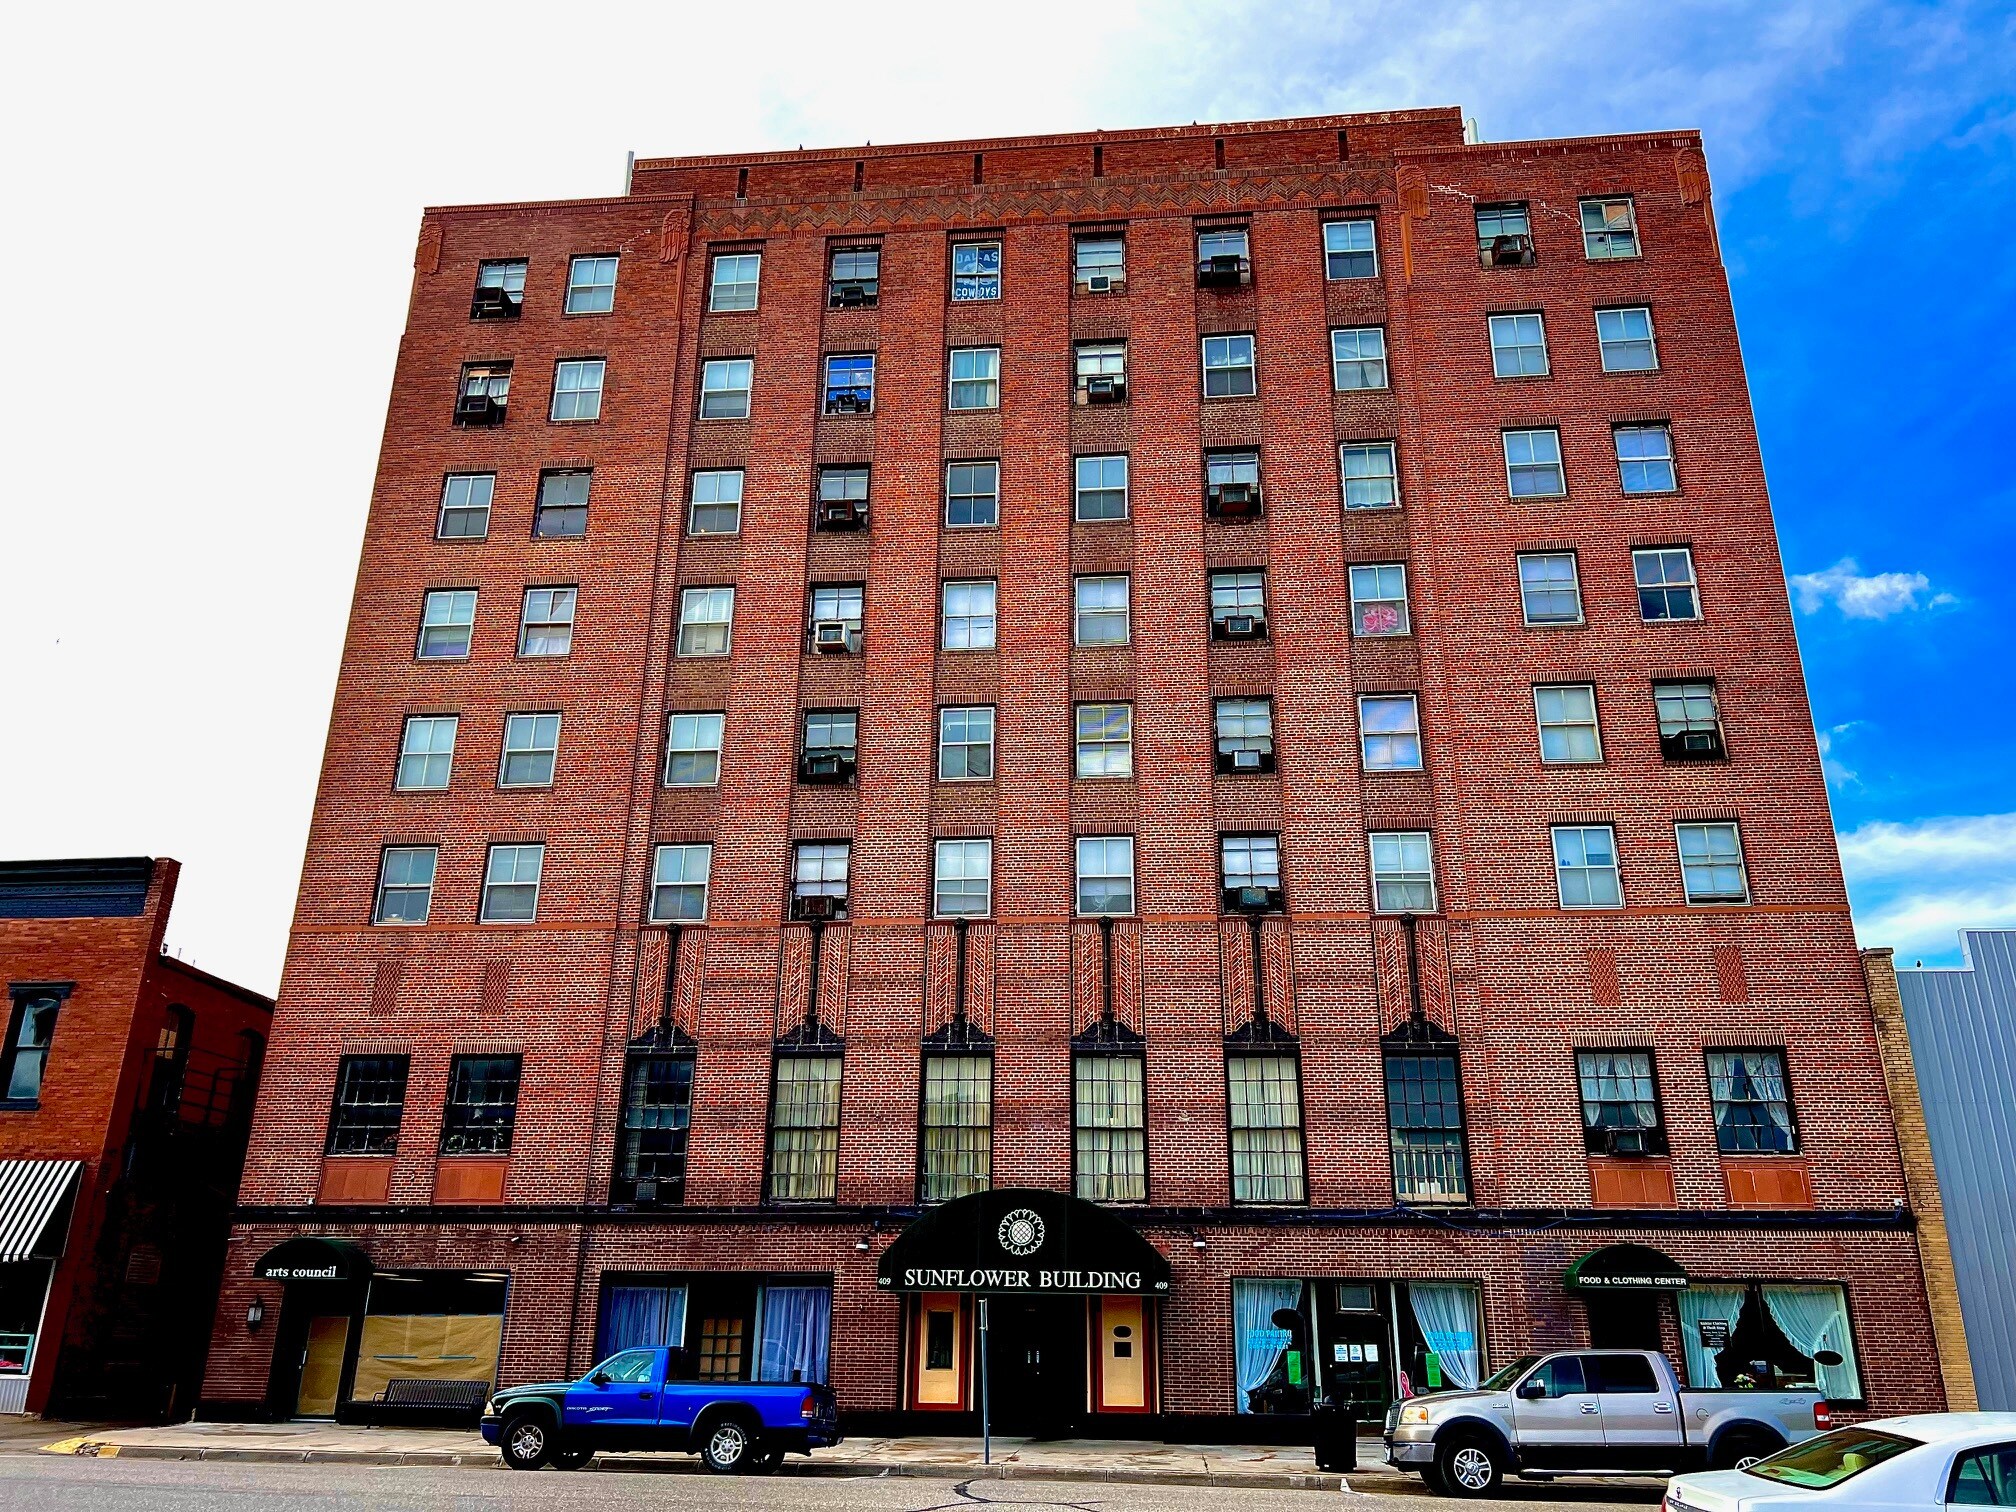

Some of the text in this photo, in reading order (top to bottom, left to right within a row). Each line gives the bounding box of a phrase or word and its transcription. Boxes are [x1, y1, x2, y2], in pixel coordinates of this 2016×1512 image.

[955, 286, 997, 297] COWOYS
[265, 1265, 337, 1278] arts council
[878, 1277, 892, 1286] 409
[904, 1268, 1142, 1289] SUNFLOWER BUILDING
[1578, 1276, 1687, 1286] FOOD & CLOTHING CENTER
[1154, 1281, 1169, 1290] 409
